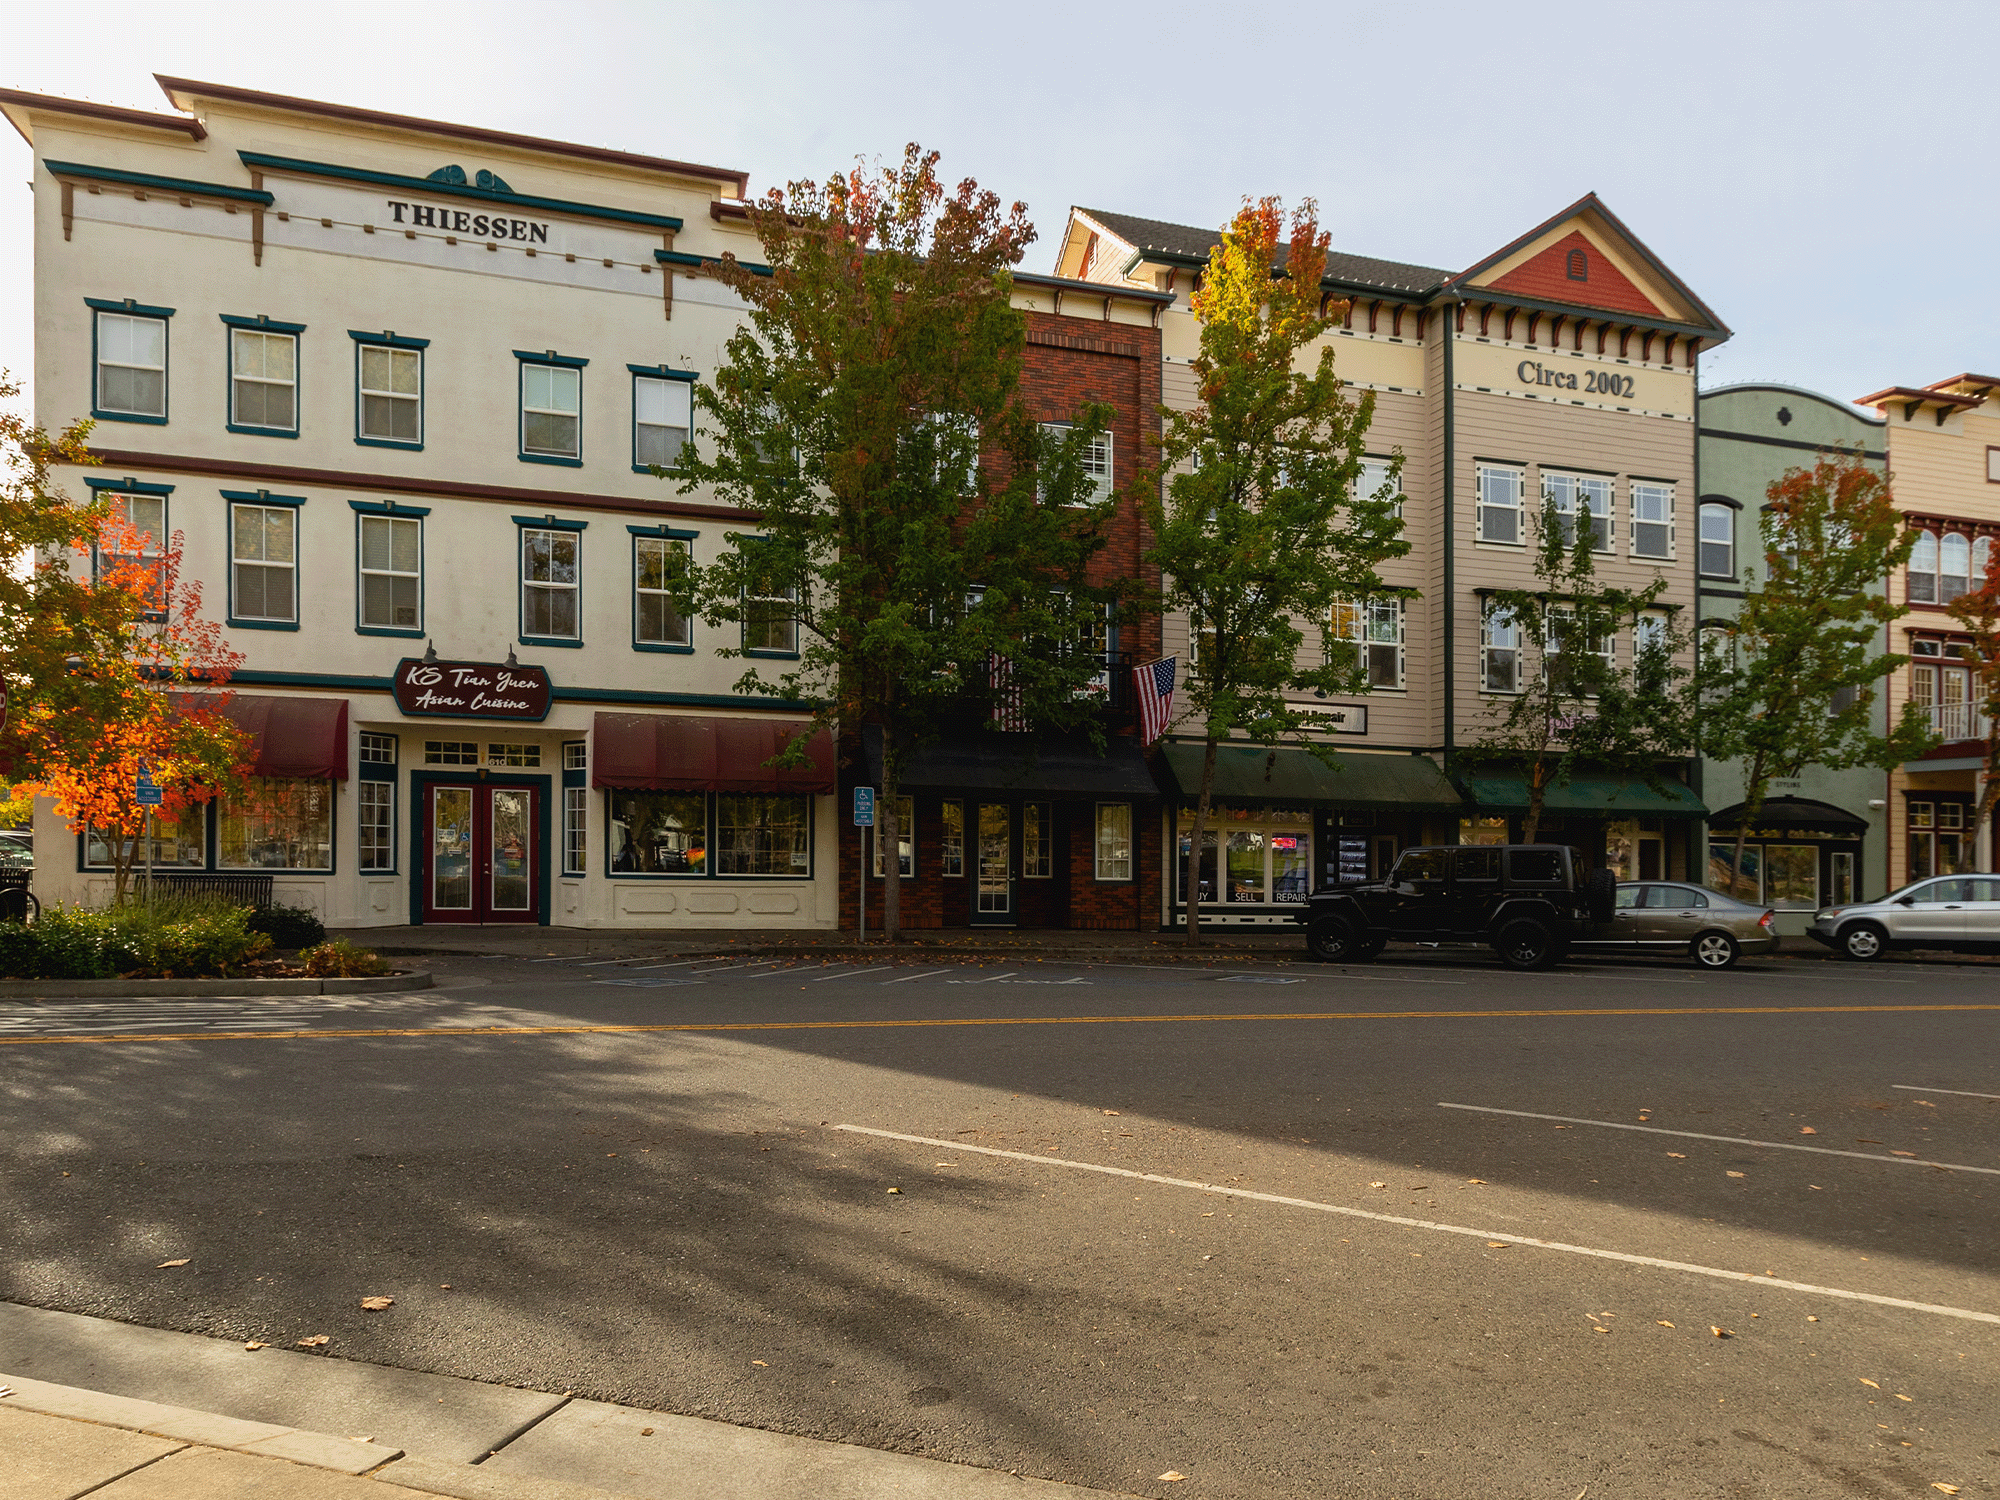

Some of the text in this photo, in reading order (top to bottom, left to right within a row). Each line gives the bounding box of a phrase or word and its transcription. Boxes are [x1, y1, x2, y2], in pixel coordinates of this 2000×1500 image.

[388, 201, 549, 244] THIESSEN
[1517, 360, 1635, 398] Circa 2002
[406, 666, 539, 692] KS Tian Yuen
[415, 689, 529, 710] Asian Cuisine
[1198, 893, 1307, 902] UY SELL REPAIR
